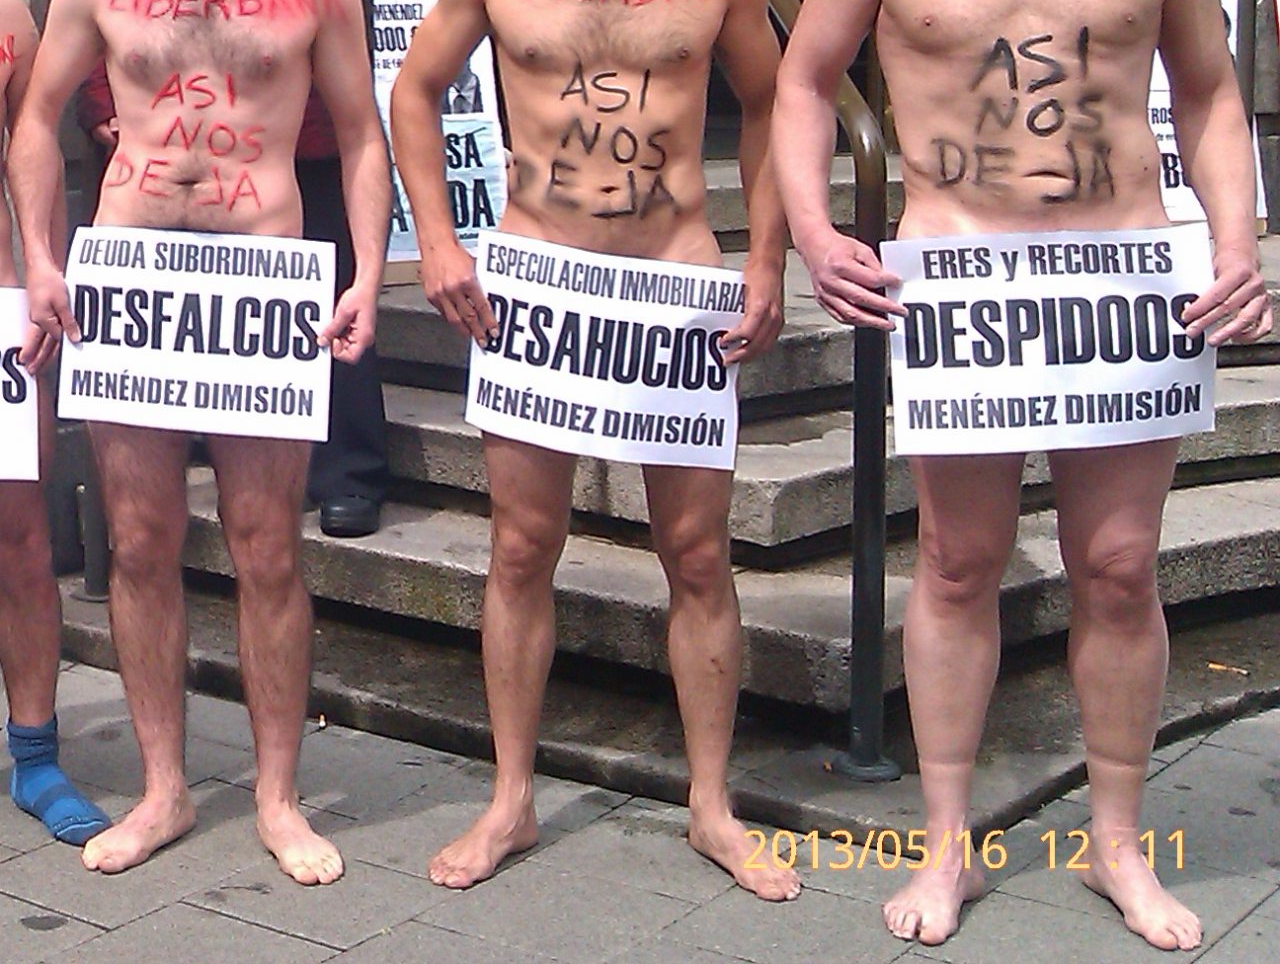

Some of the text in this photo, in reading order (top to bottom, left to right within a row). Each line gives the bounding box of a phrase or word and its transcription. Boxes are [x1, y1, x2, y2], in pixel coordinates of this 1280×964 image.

[560, 59, 652, 113] ASI
[970, 26, 1092, 93] ASI
[151, 72, 236, 110] ASI
[974, 93, 1105, 137] NOS
[162, 115, 268, 164] NOS
[561, 118, 671, 171] NOS
[104, 153, 262, 213] DEJA
[930, 137, 1117, 205] DEJA
[79, 238, 322, 281] DEUDA SUBORDINADA
[486, 243, 747, 314] ESPECULACION INMOBILIARIA
[921, 241, 1173, 282] ERES y RECORTES
[74, 284, 321, 361] DESFALCOS
[486, 292, 730, 392] DESAHUCIOS
[902, 293, 1206, 370] DESPIDOOS
[71, 369, 314, 417] MENÉNDEZ DIMISIÓN
[476, 377, 726, 448] MENÉNDEZ DIMISIÓN
[908, 382, 1202, 430] MENÉNDEZ DIMISIÓN
